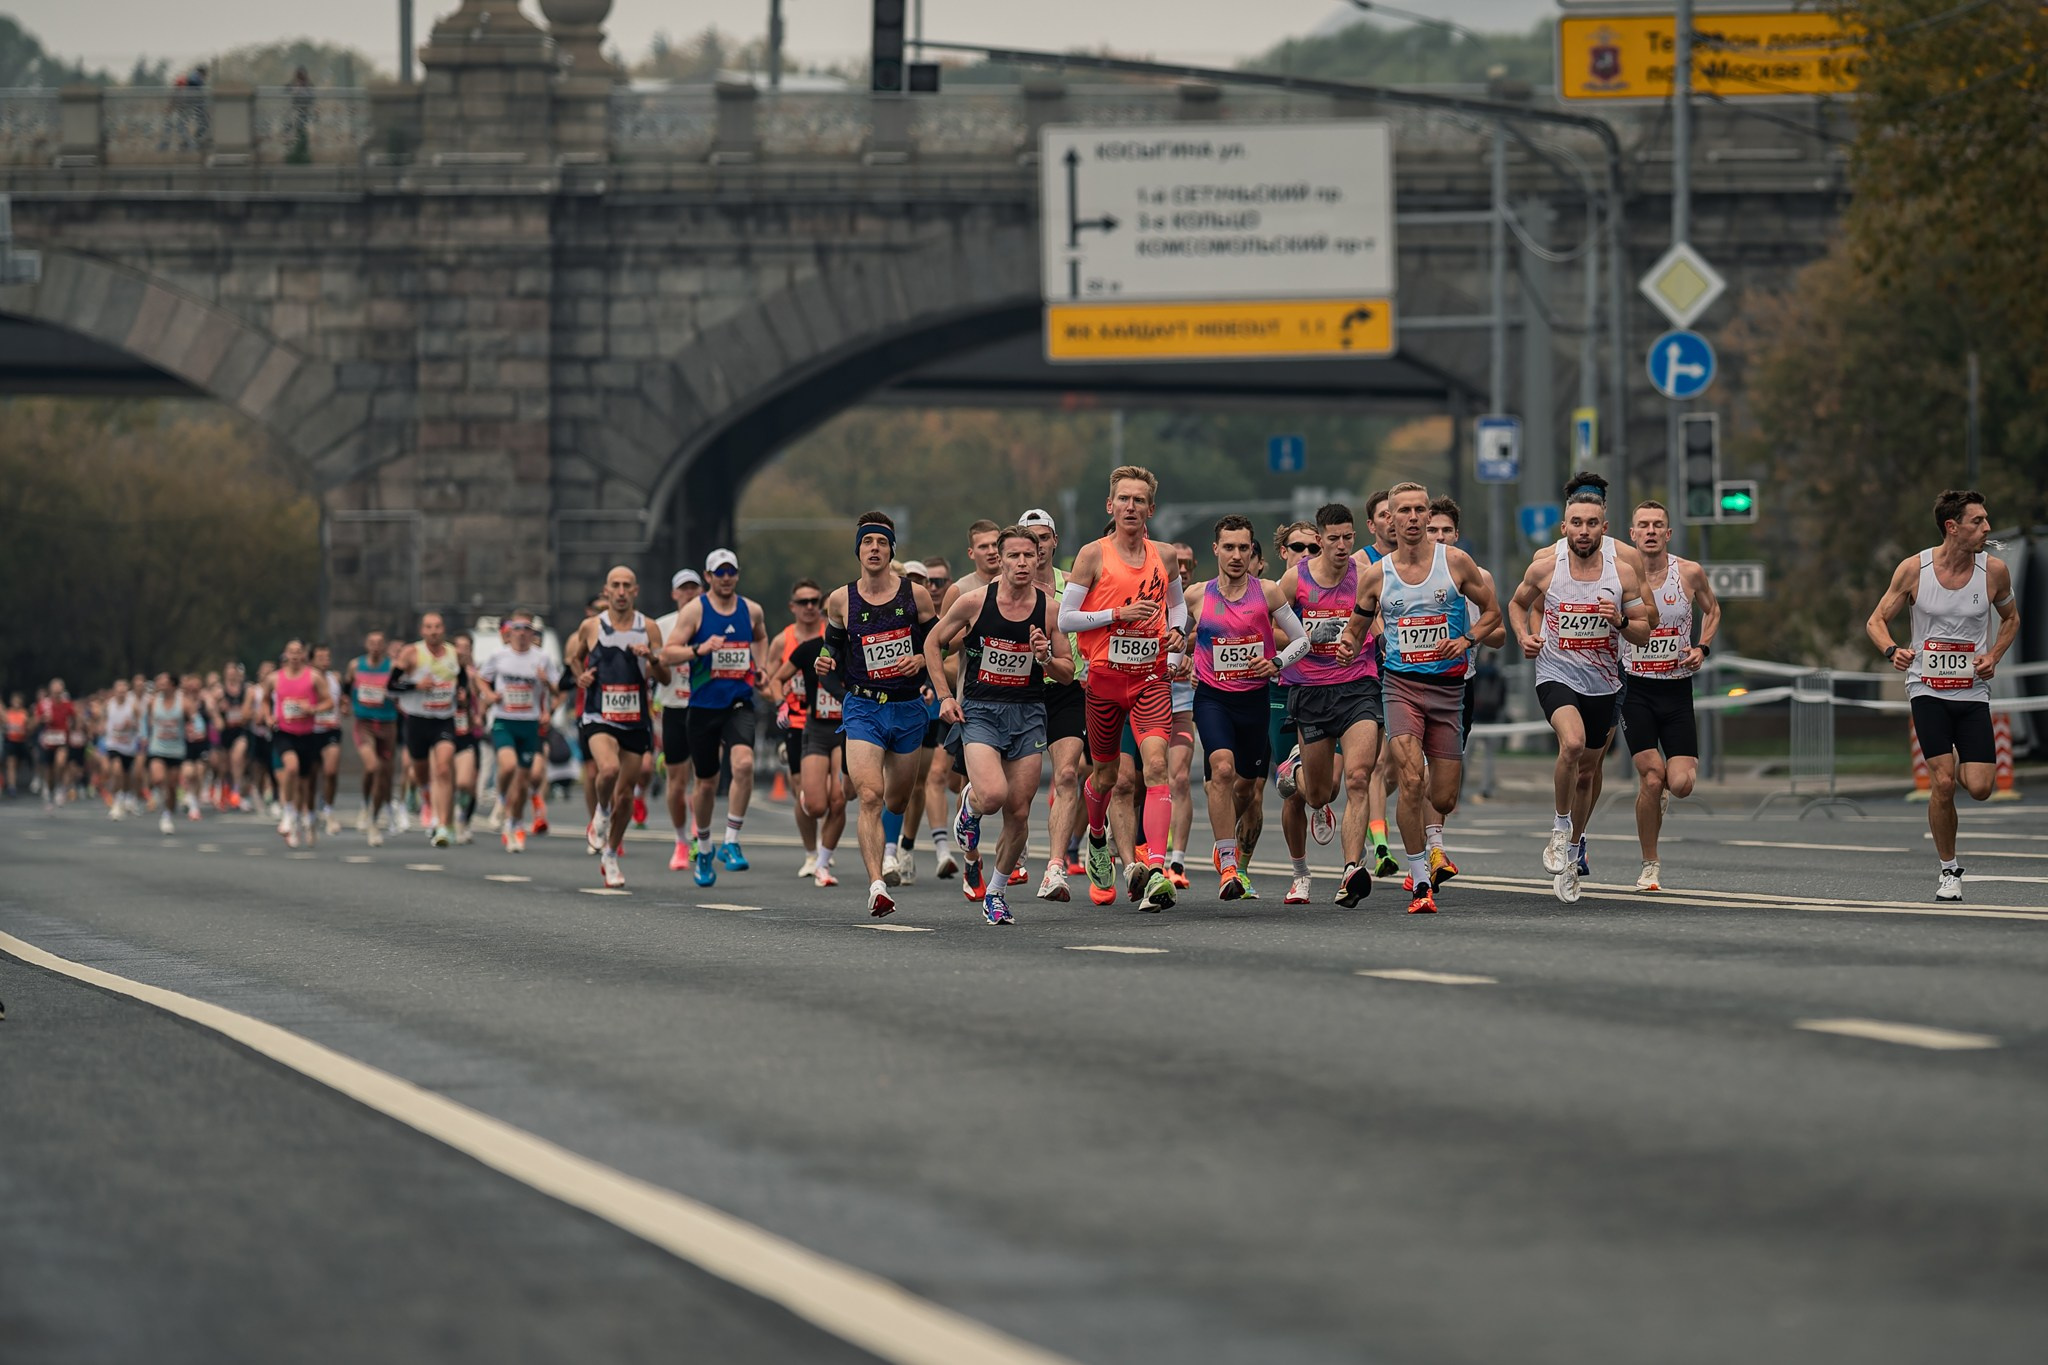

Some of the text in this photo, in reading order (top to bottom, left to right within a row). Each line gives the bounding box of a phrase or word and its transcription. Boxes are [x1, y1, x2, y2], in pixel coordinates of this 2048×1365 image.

[1560, 615, 1609, 630] 24974
[1401, 626, 1448, 644] 19770
[866, 639, 911, 662] 12528
[1112, 639, 1158, 656] 15869
[1219, 645, 1258, 662] 6534
[717, 651, 746, 664] 5832
[988, 650, 1027, 669] 8829
[1928, 654, 1967, 669] 3103
[605, 694, 637, 707] 16091
